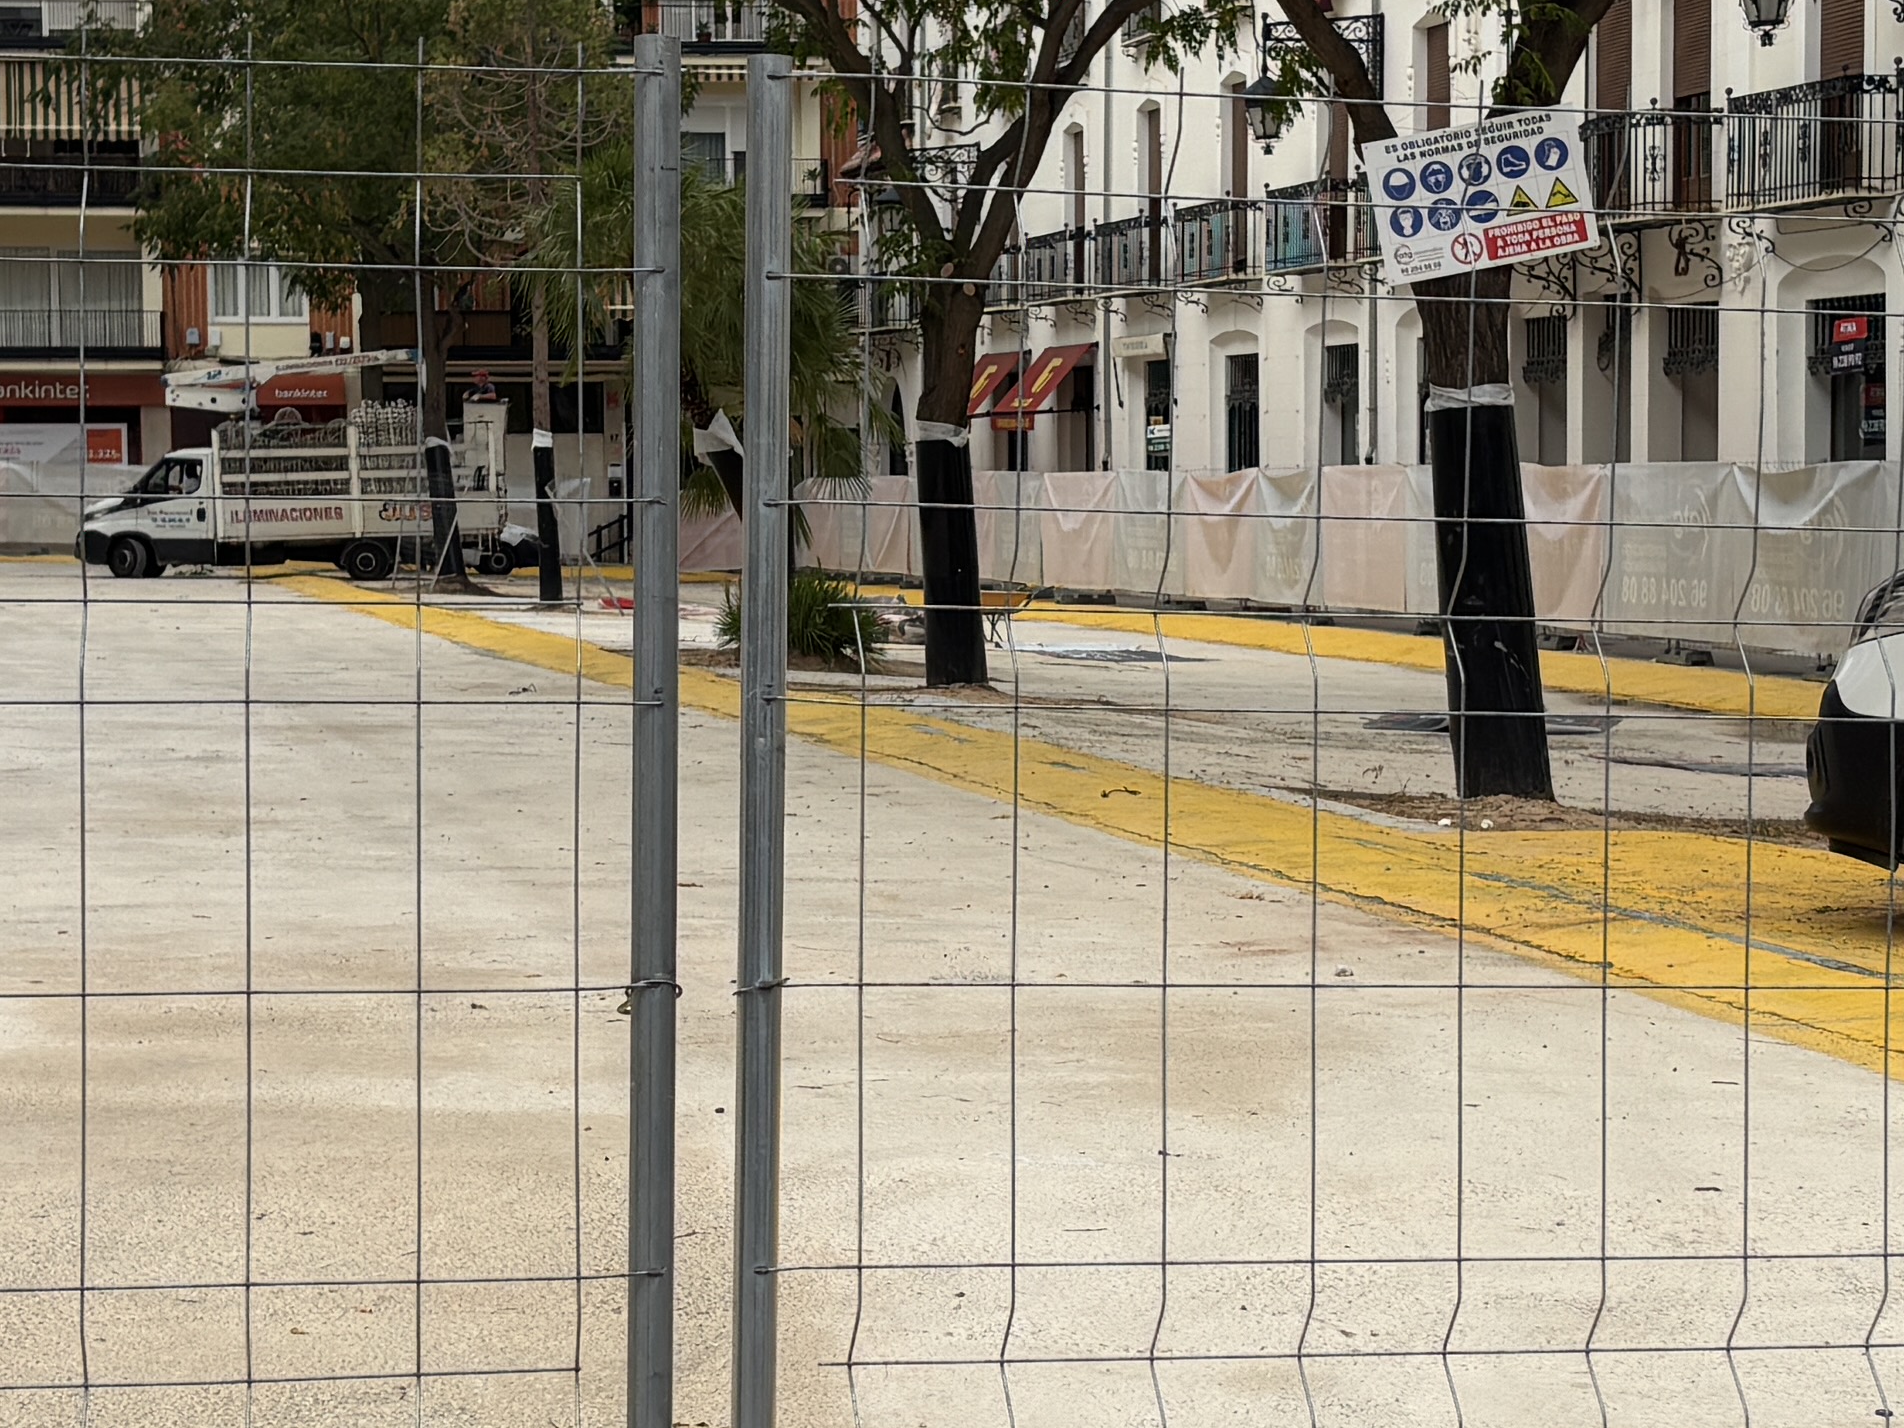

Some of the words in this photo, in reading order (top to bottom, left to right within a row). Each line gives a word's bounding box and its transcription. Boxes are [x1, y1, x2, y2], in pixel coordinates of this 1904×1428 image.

[1384, 145, 1399, 155] ES
[1400, 130, 1472, 151] OBLIGATORIO
[1474, 119, 1515, 137] SEGUIR
[1516, 114, 1552, 128] TODAS
[1396, 153, 1417, 164] LAS
[1419, 142, 1464, 160] NORMAS
[1483, 126, 1545, 146] SEGURIDAD
[1487, 220, 1540, 239] PROHIBIDO
[1541, 218, 1555, 227] EL
[1556, 212, 1582, 225] PASO
[1496, 239, 1504, 247] A
[1506, 233, 1531, 245] TODA
[1532, 223, 1577, 239] PERSONA
[1497, 244, 1528, 257] AJENA
[1530, 242, 1538, 251] A
[1539, 239, 1552, 249] LA
[1553, 233, 1581, 246] OBRA
[274, 387, 328, 399] bankinter
[230, 506, 343, 523] ILMINACIONES
